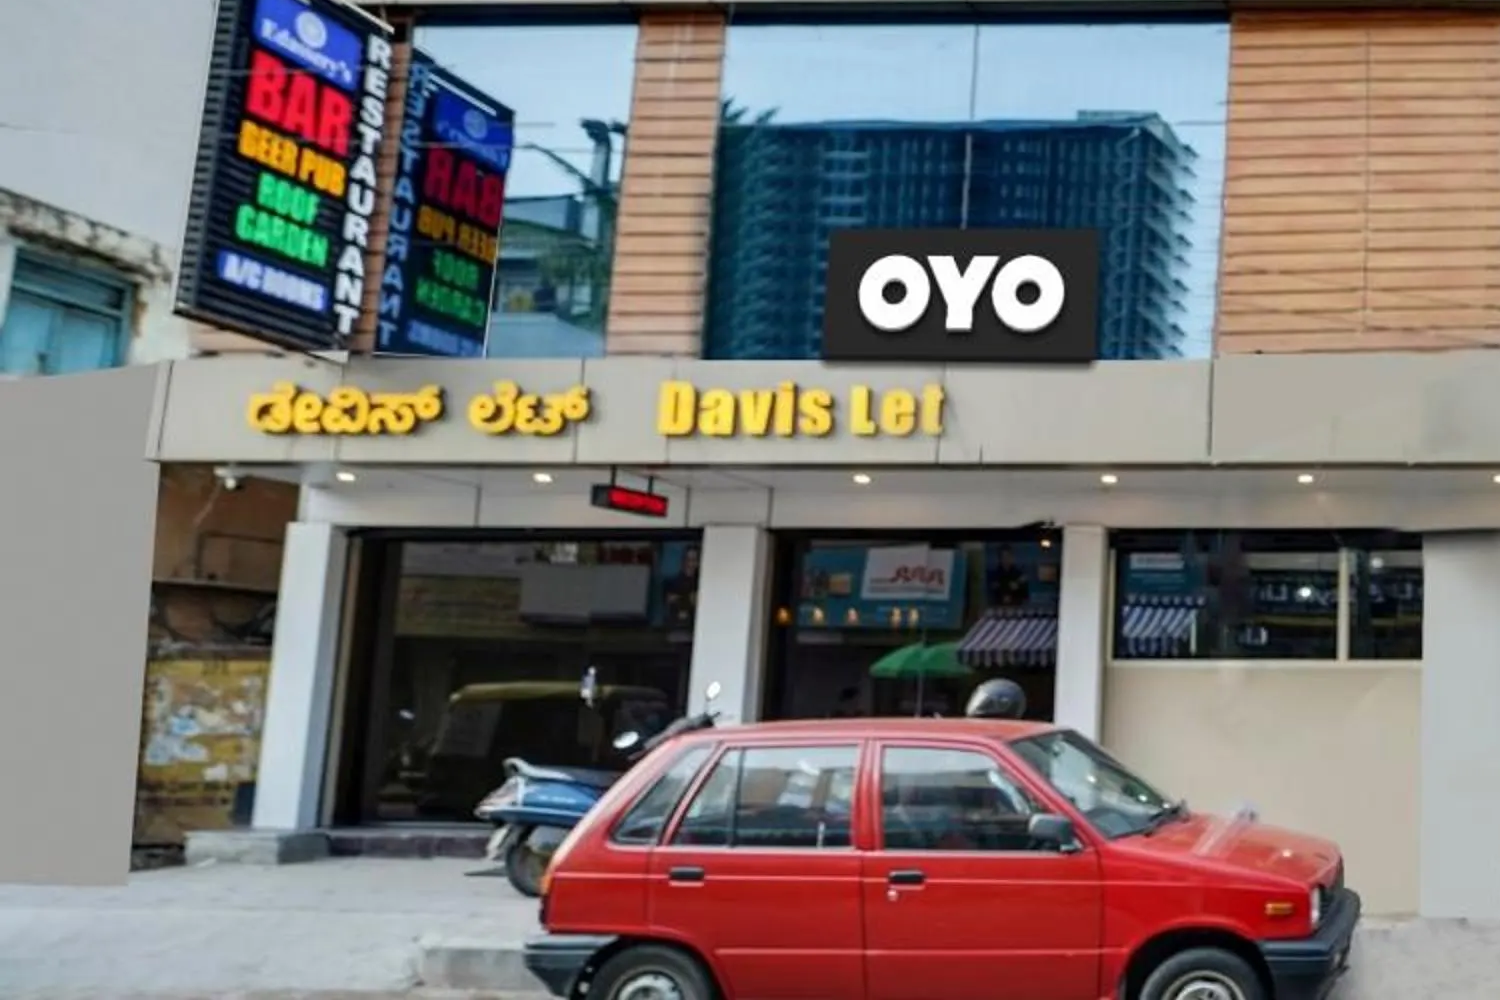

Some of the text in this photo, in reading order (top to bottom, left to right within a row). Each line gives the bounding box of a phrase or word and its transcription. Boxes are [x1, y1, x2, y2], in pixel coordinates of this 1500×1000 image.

[246, 50, 352, 156] BAR
[238, 120, 345, 196] BEER PUB
[333, 33, 392, 335] RESTAURANT
[236, 204, 328, 268] GARDEN
[859, 254, 1065, 333] OYO
[248, 379, 590, 435] ಡೇವಿಸ್ ಲೆಟ್
[658, 379, 946, 437] Davis Let
